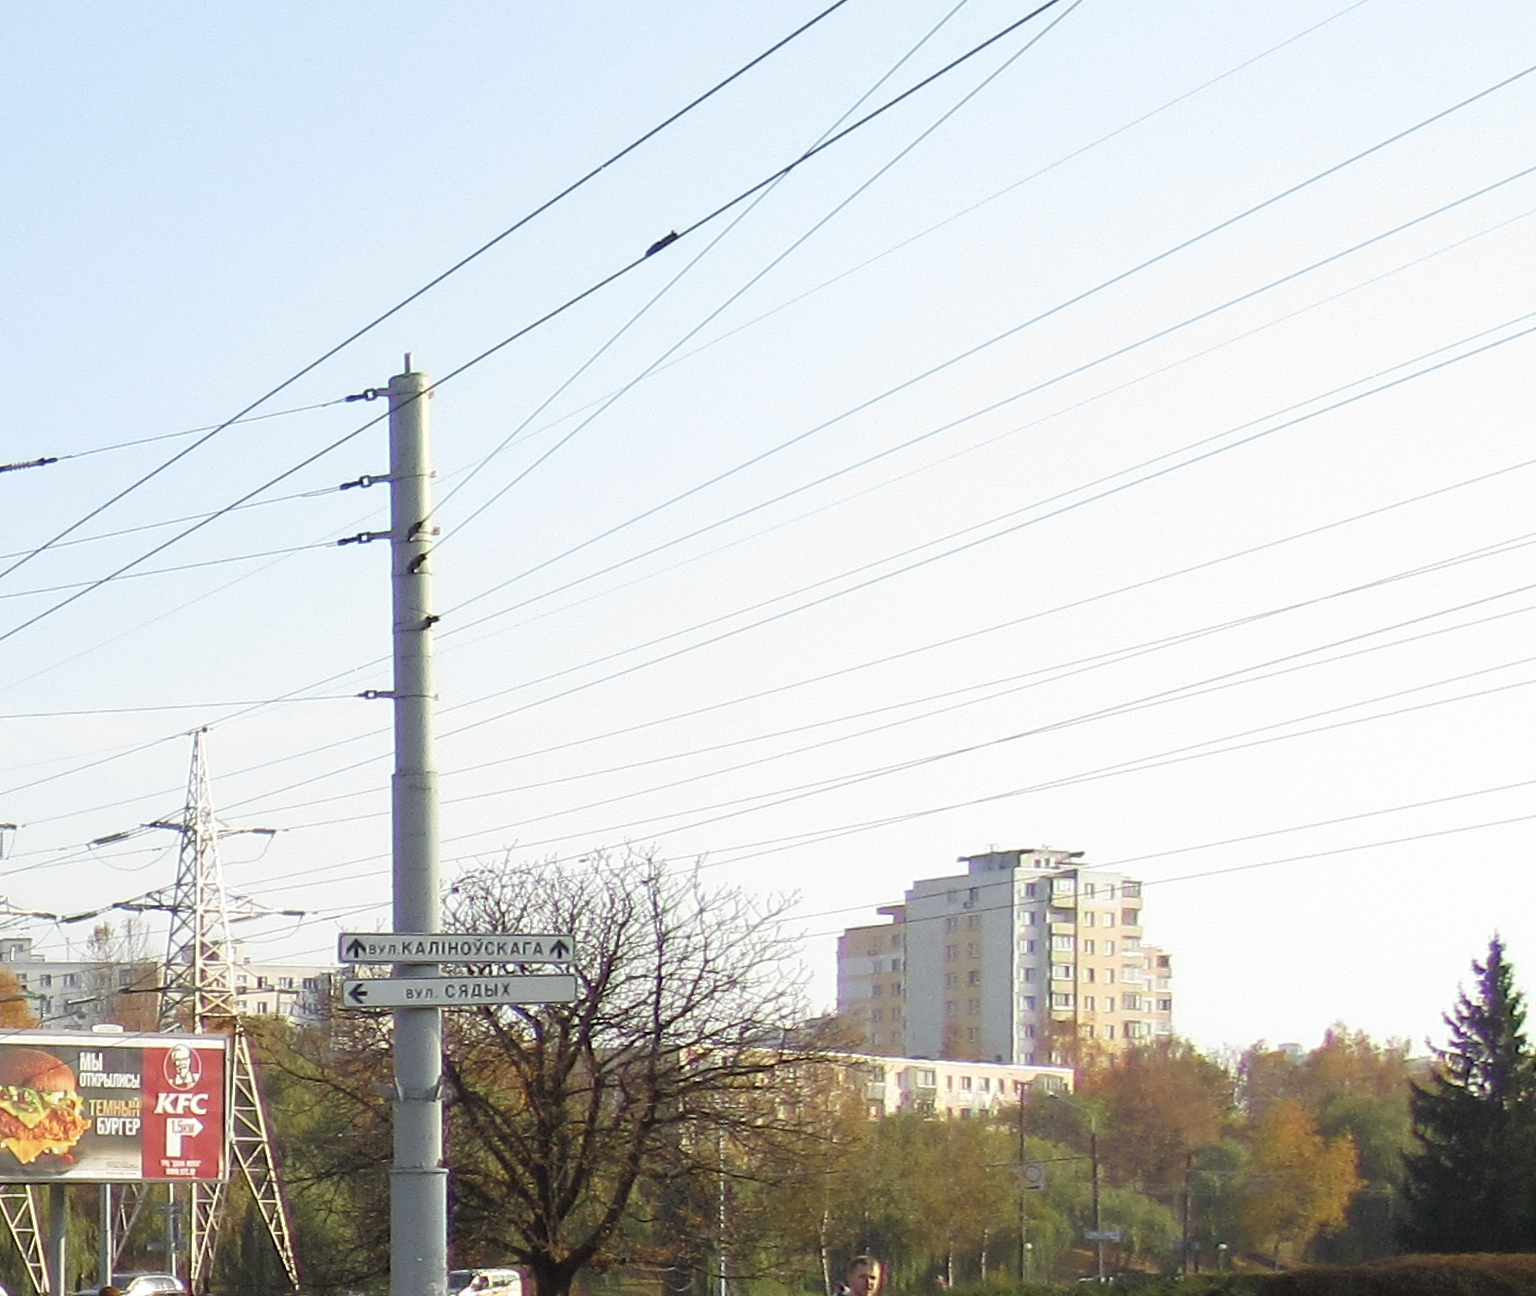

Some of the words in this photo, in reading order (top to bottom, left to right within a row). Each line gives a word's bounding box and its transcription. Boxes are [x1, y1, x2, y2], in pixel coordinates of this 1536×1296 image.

[444, 983, 511, 999] СЯДЫХ
[80, 1052, 103, 1071] МЫ
[89, 1097, 141, 1117] ТЕМНЫЙ
[153, 1092, 210, 1115] KFC
[96, 1117, 141, 1136] БУРГЕР
